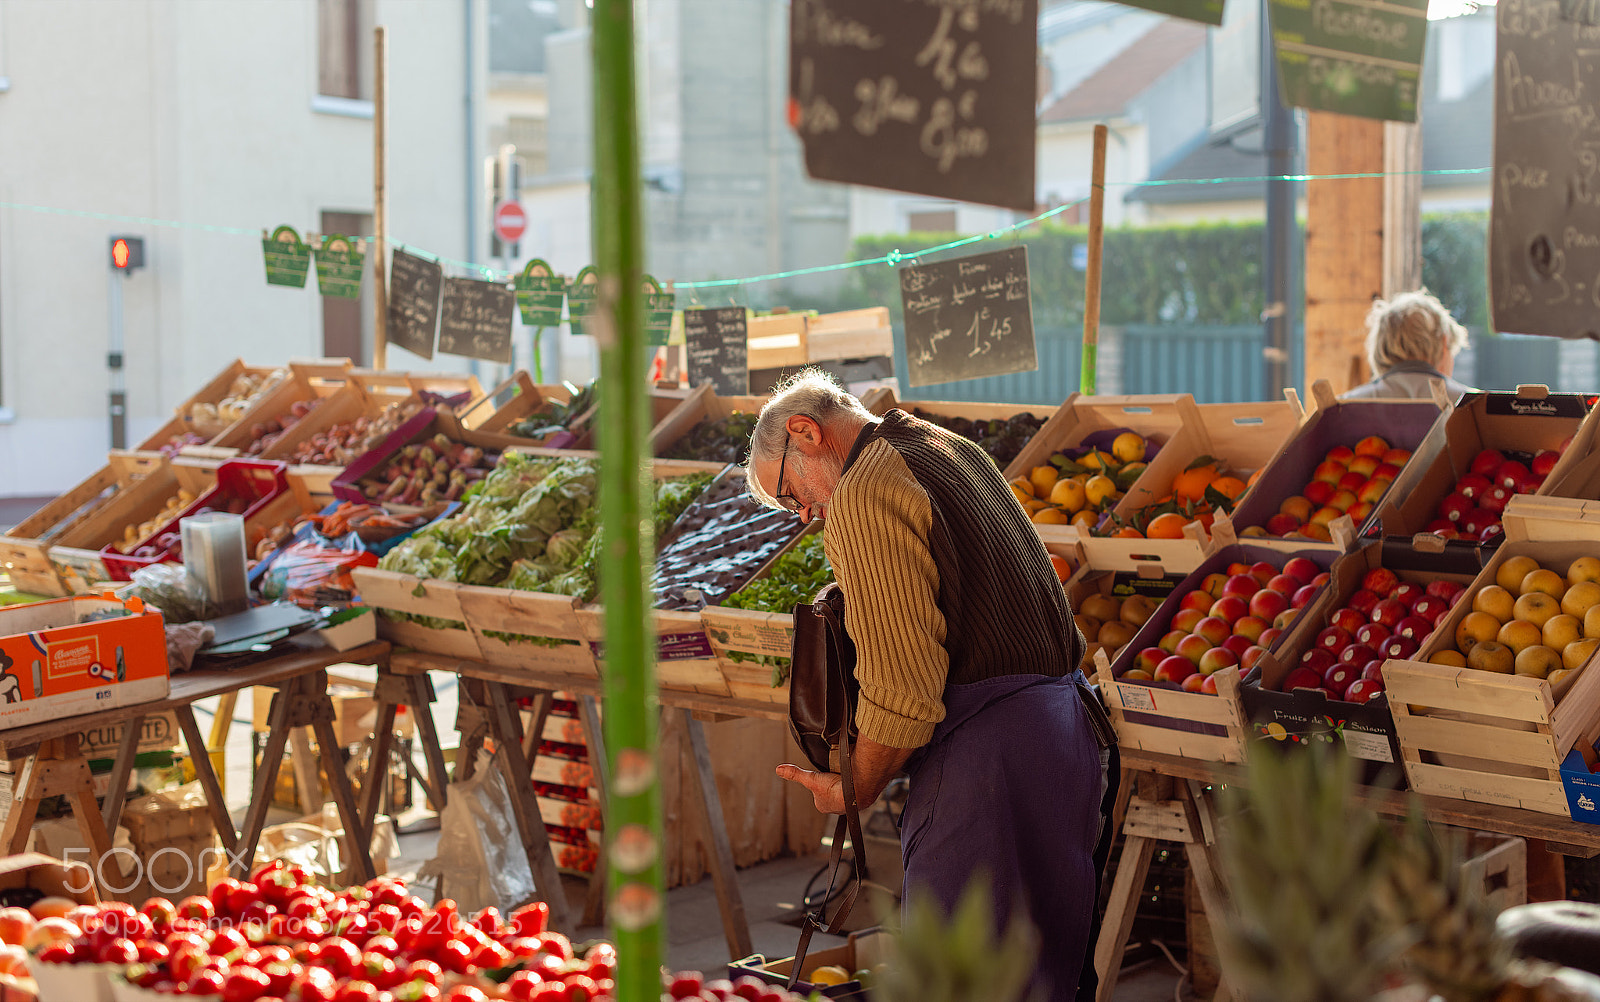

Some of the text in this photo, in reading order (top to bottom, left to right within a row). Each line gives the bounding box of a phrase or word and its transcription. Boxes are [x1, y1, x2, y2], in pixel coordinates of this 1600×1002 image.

[1, 707, 30, 716] PLANTEUR
[1274, 710, 1386, 734] Fruits de Saison
